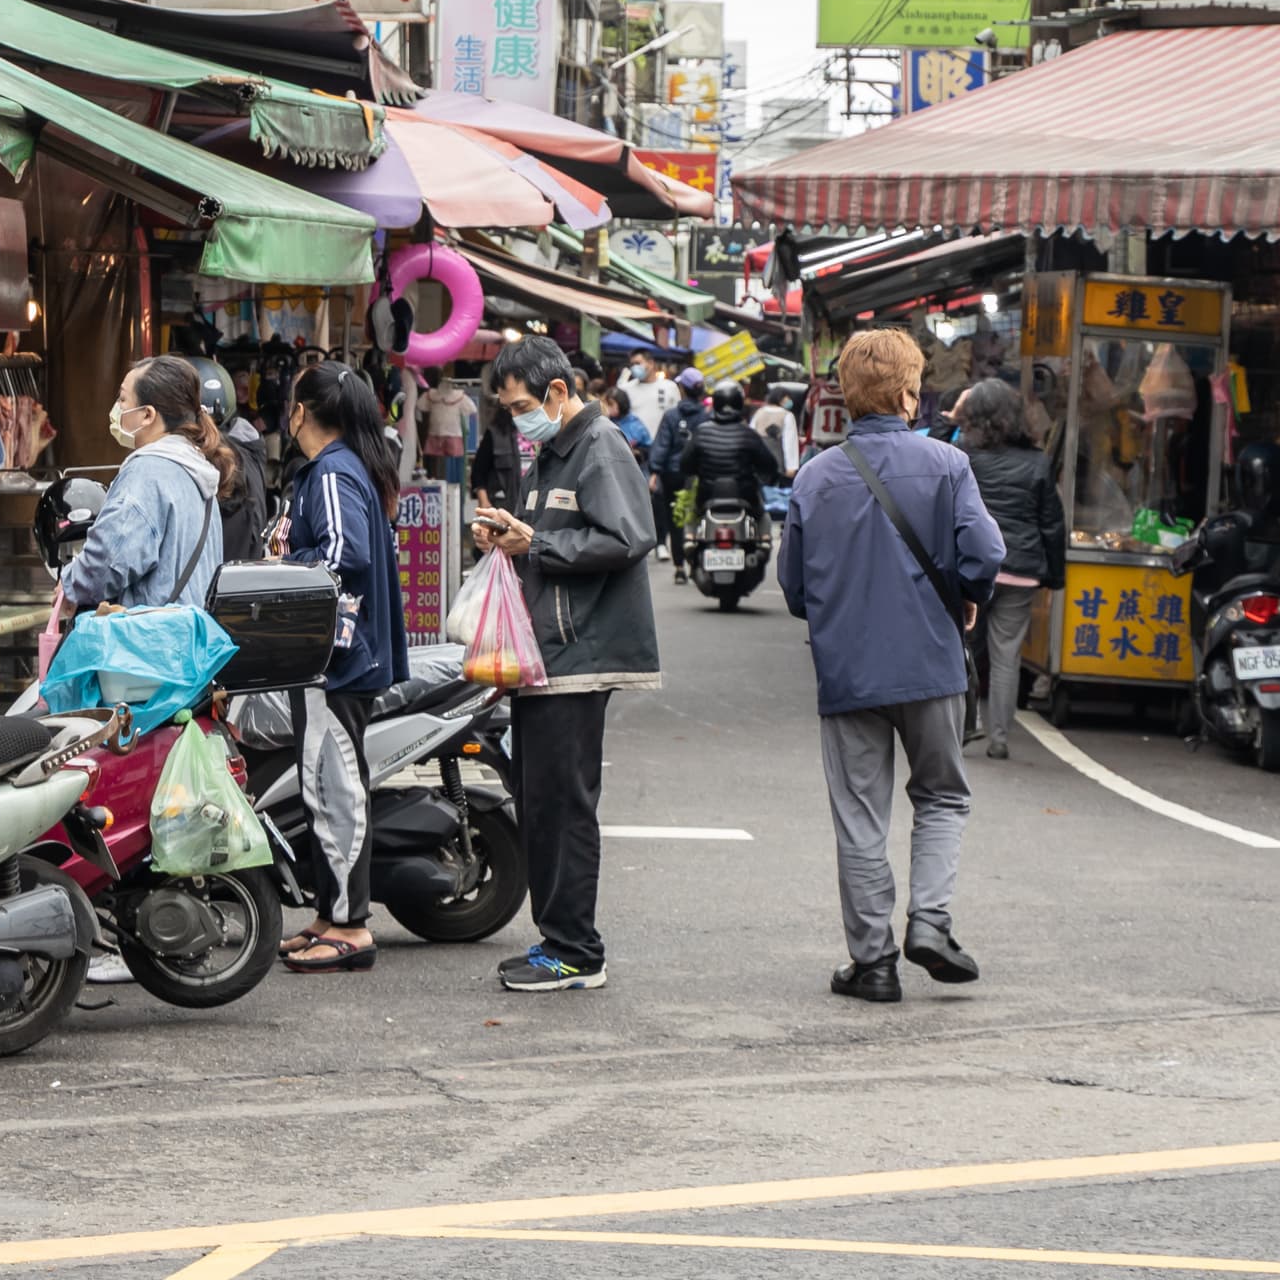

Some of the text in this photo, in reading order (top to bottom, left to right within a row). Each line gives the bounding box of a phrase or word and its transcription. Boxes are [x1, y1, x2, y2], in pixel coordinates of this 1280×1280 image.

[452, 34, 486, 95] 生活
[822, 408, 843, 433] 11
[420, 529, 440, 545] 100
[420, 550, 440, 565] 150
[417, 572, 440, 586] 200
[417, 592, 440, 607] 200
[1073, 586, 1186, 626] 甘蔗雞
[417, 612, 440, 627] 300
[1071, 623, 1183, 664] 鹽水雞
